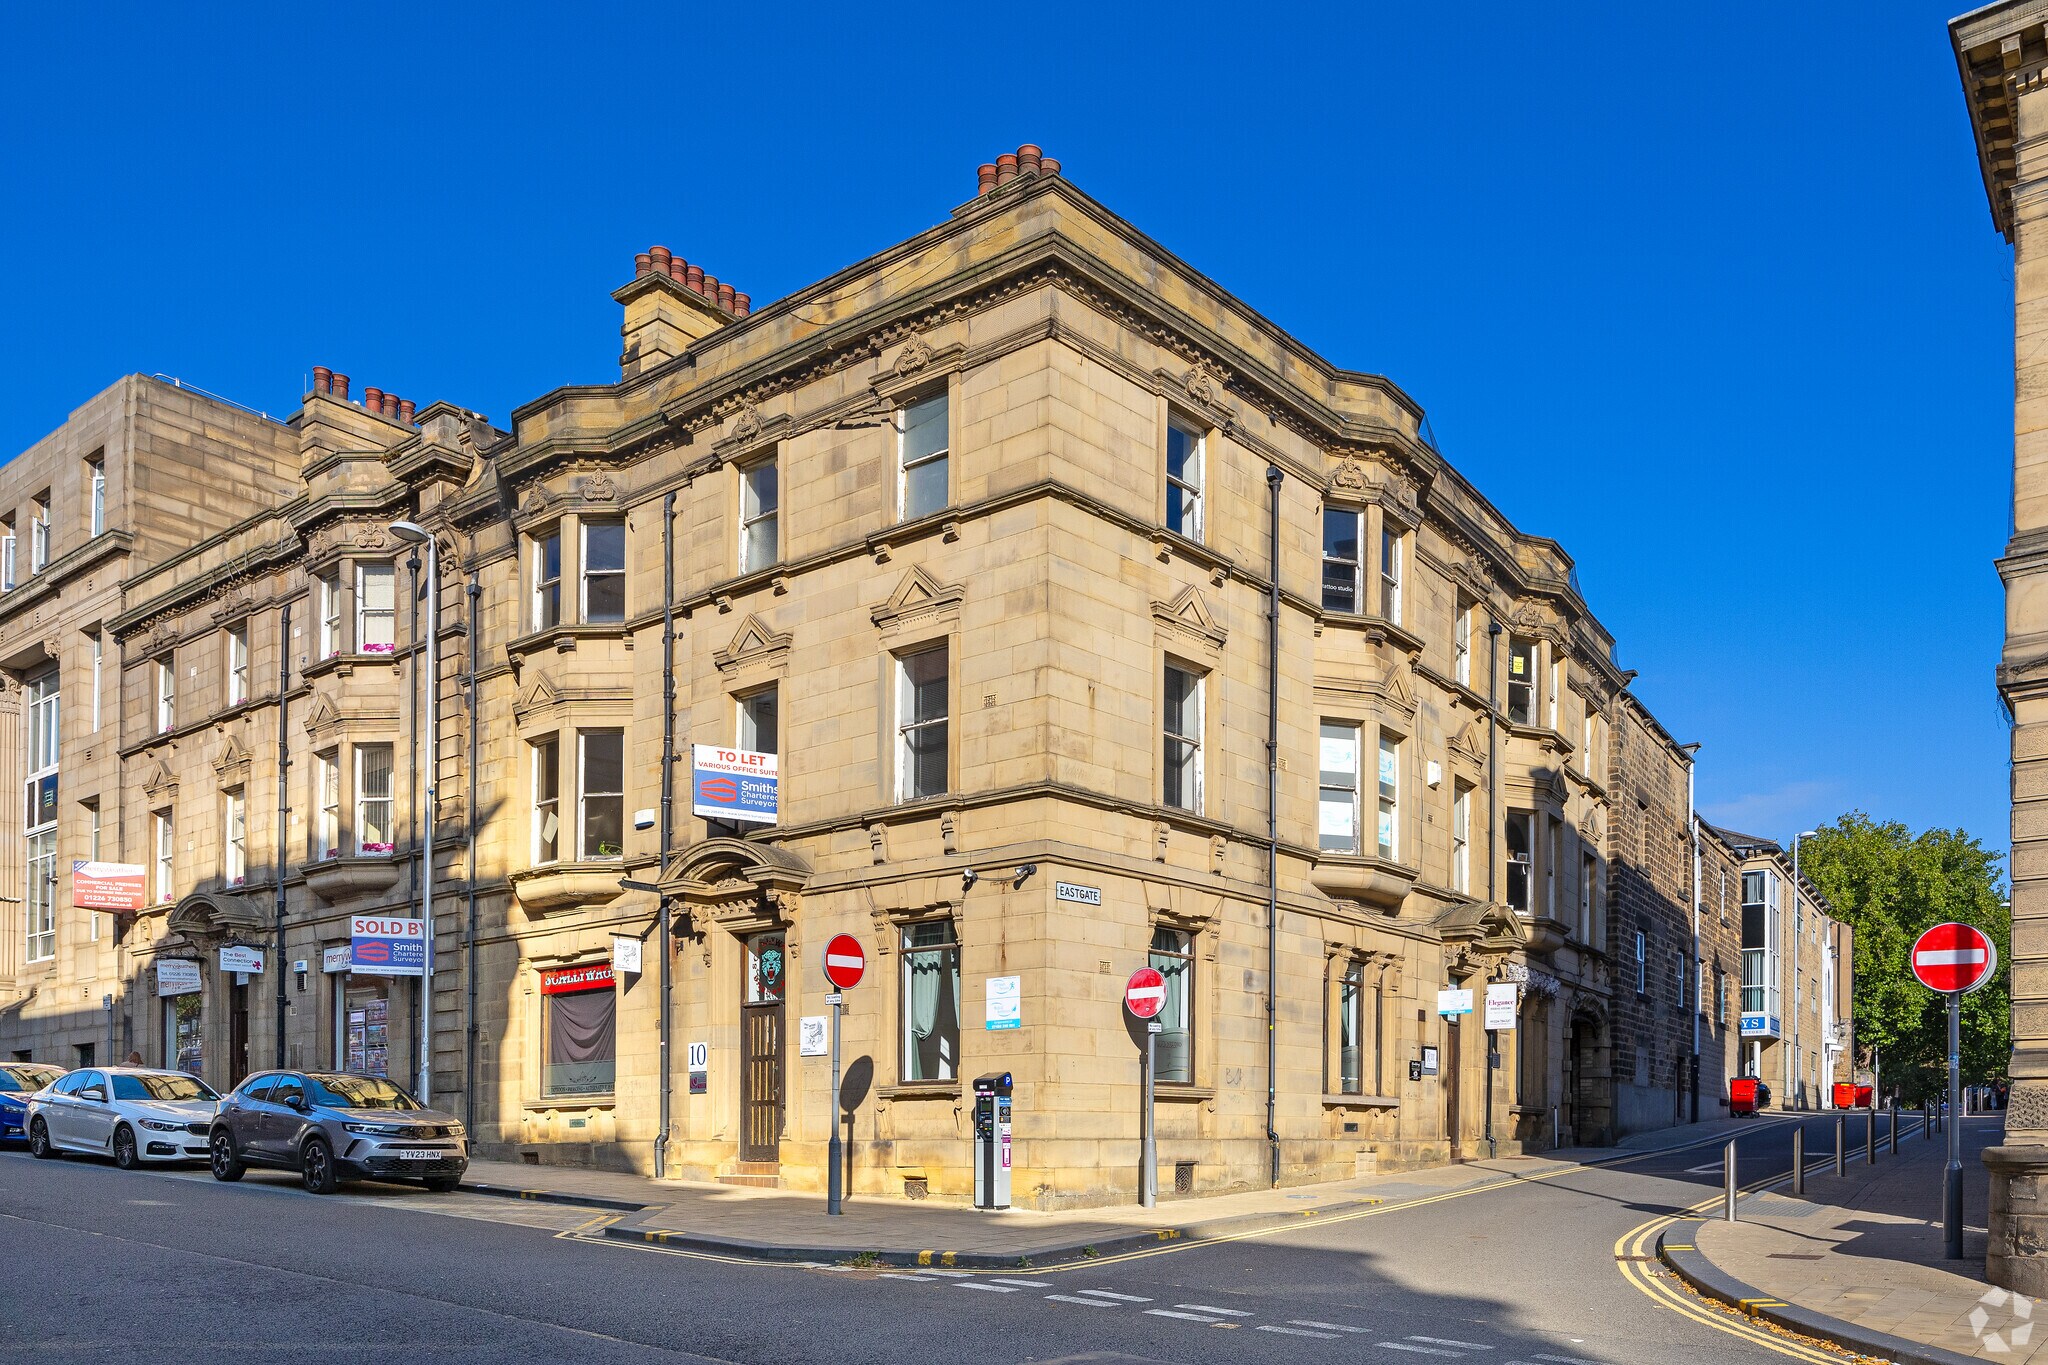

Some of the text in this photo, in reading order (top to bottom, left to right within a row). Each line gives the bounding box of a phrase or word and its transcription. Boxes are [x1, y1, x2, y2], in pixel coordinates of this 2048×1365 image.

[717, 751, 766, 766] TO LET
[698, 761, 731, 770] VARIOUS
[732, 765, 757, 774] OFFICE
[741, 781, 778, 794] Smiths
[1059, 886, 1098, 902] EASTGATE
[355, 920, 403, 935] SOLD
[393, 942, 423, 952] Smith
[393, 950, 424, 958] Chartere
[1488, 999, 1515, 1008] Elegance
[690, 1044, 706, 1066] 10
[405, 1150, 441, 1158] YV23 HNX
